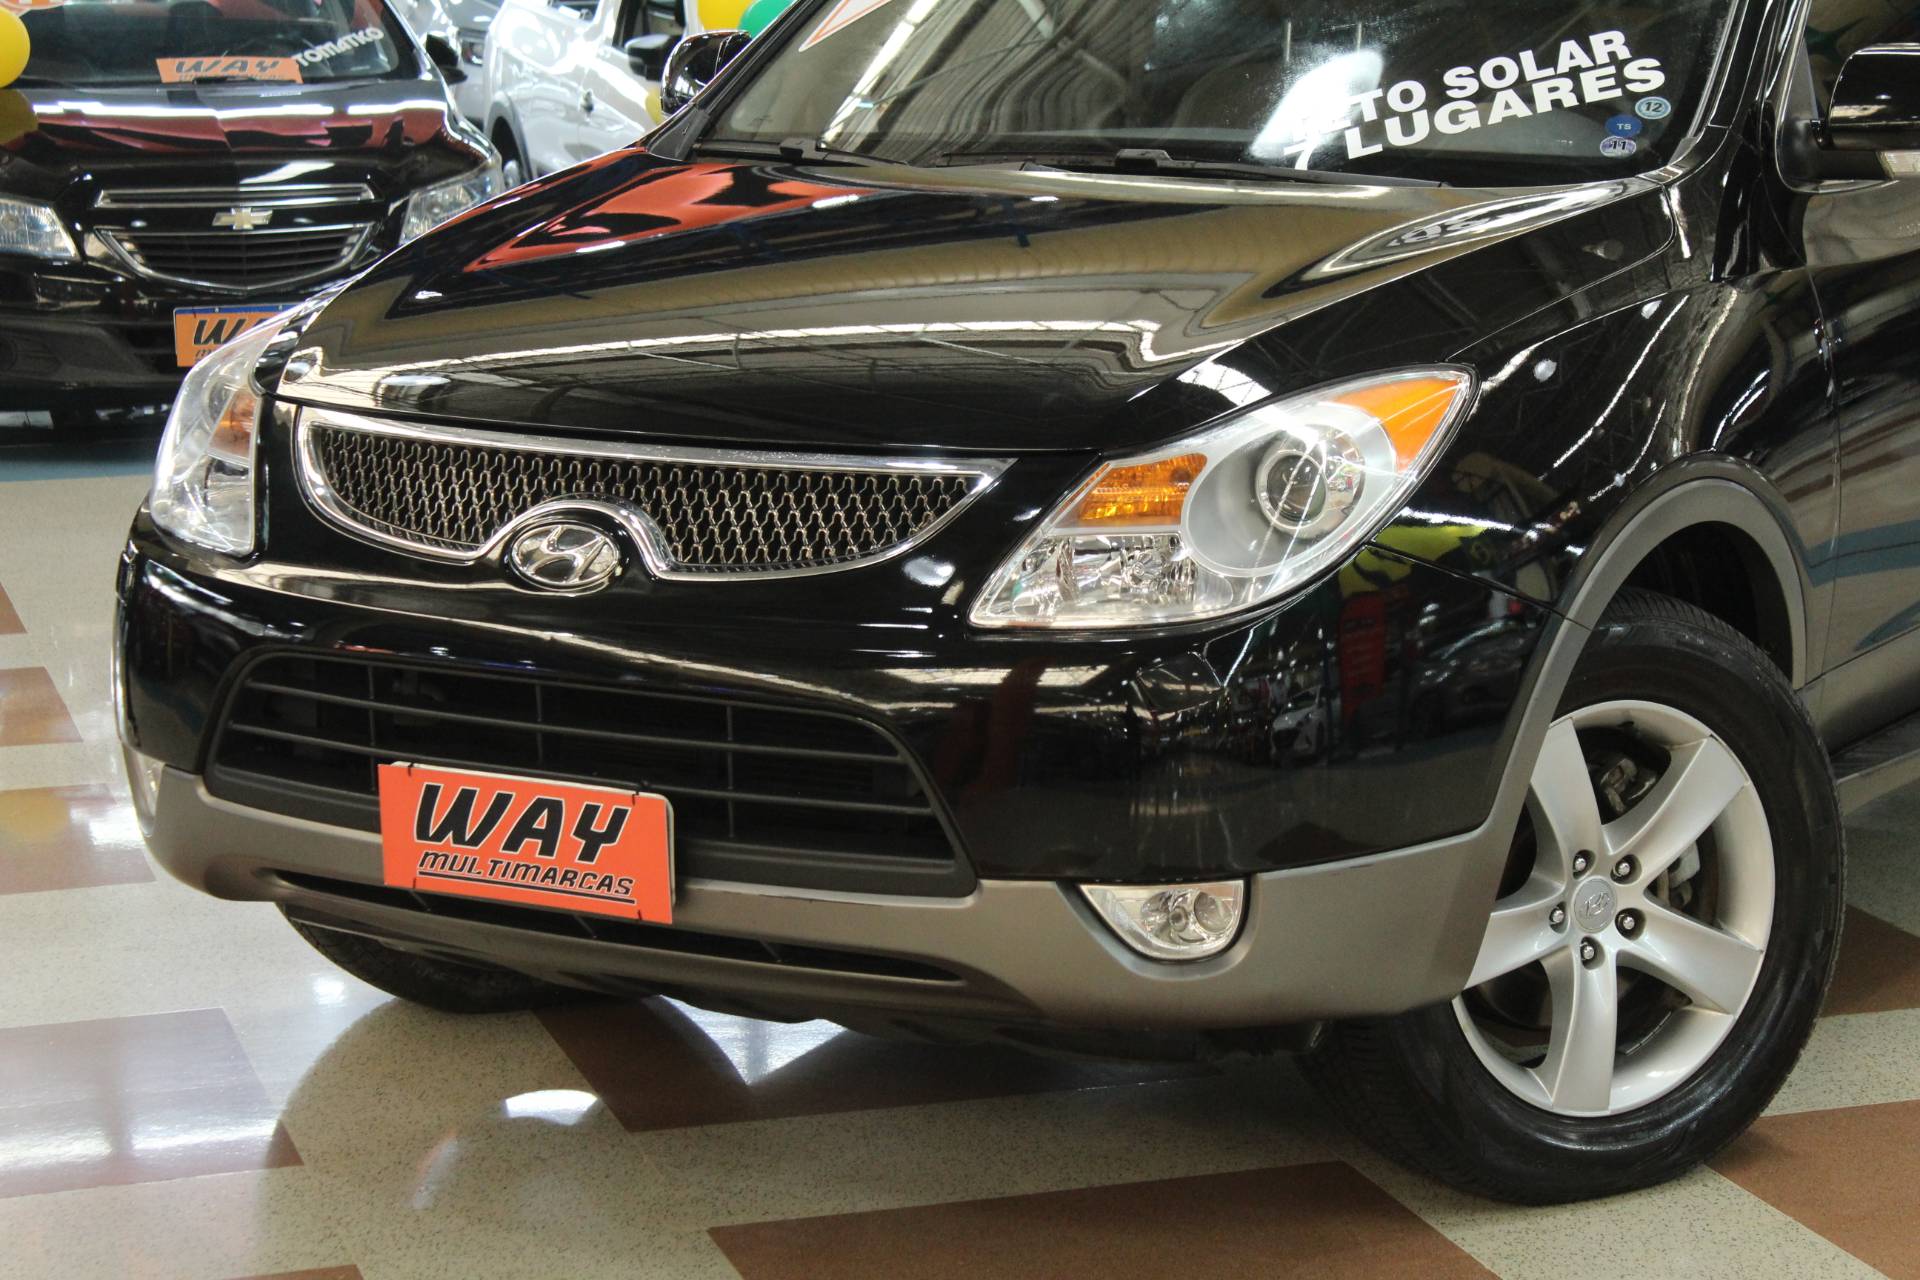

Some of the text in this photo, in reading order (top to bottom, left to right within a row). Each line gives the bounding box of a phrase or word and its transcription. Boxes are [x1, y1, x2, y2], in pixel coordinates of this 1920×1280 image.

[175, 60, 279, 74] WAY
[1443, 30, 1632, 99] SOLAR
[1344, 58, 1666, 160] LUGARES
[1645, 101, 1663, 113] 12
[1612, 140, 1627, 150] 11
[414, 782, 632, 865] WAY
[417, 850, 636, 897] MULTIMARCAS
